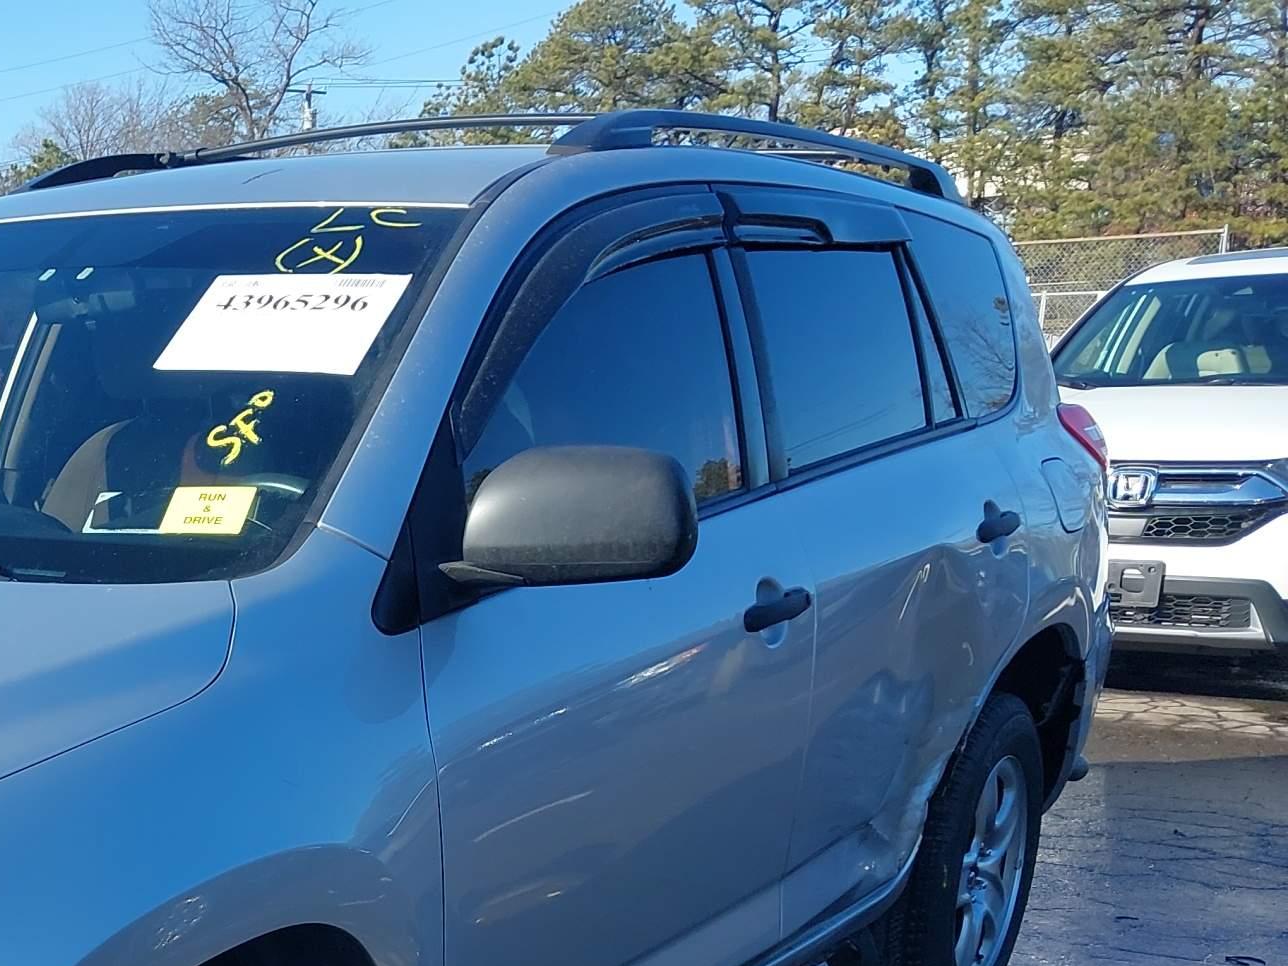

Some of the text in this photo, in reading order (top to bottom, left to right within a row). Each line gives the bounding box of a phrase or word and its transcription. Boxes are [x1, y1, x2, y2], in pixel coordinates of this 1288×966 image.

[216, 294, 369, 311] 43965296
[199, 493, 227, 501] RUN
[183, 516, 224, 525] DRIVE
